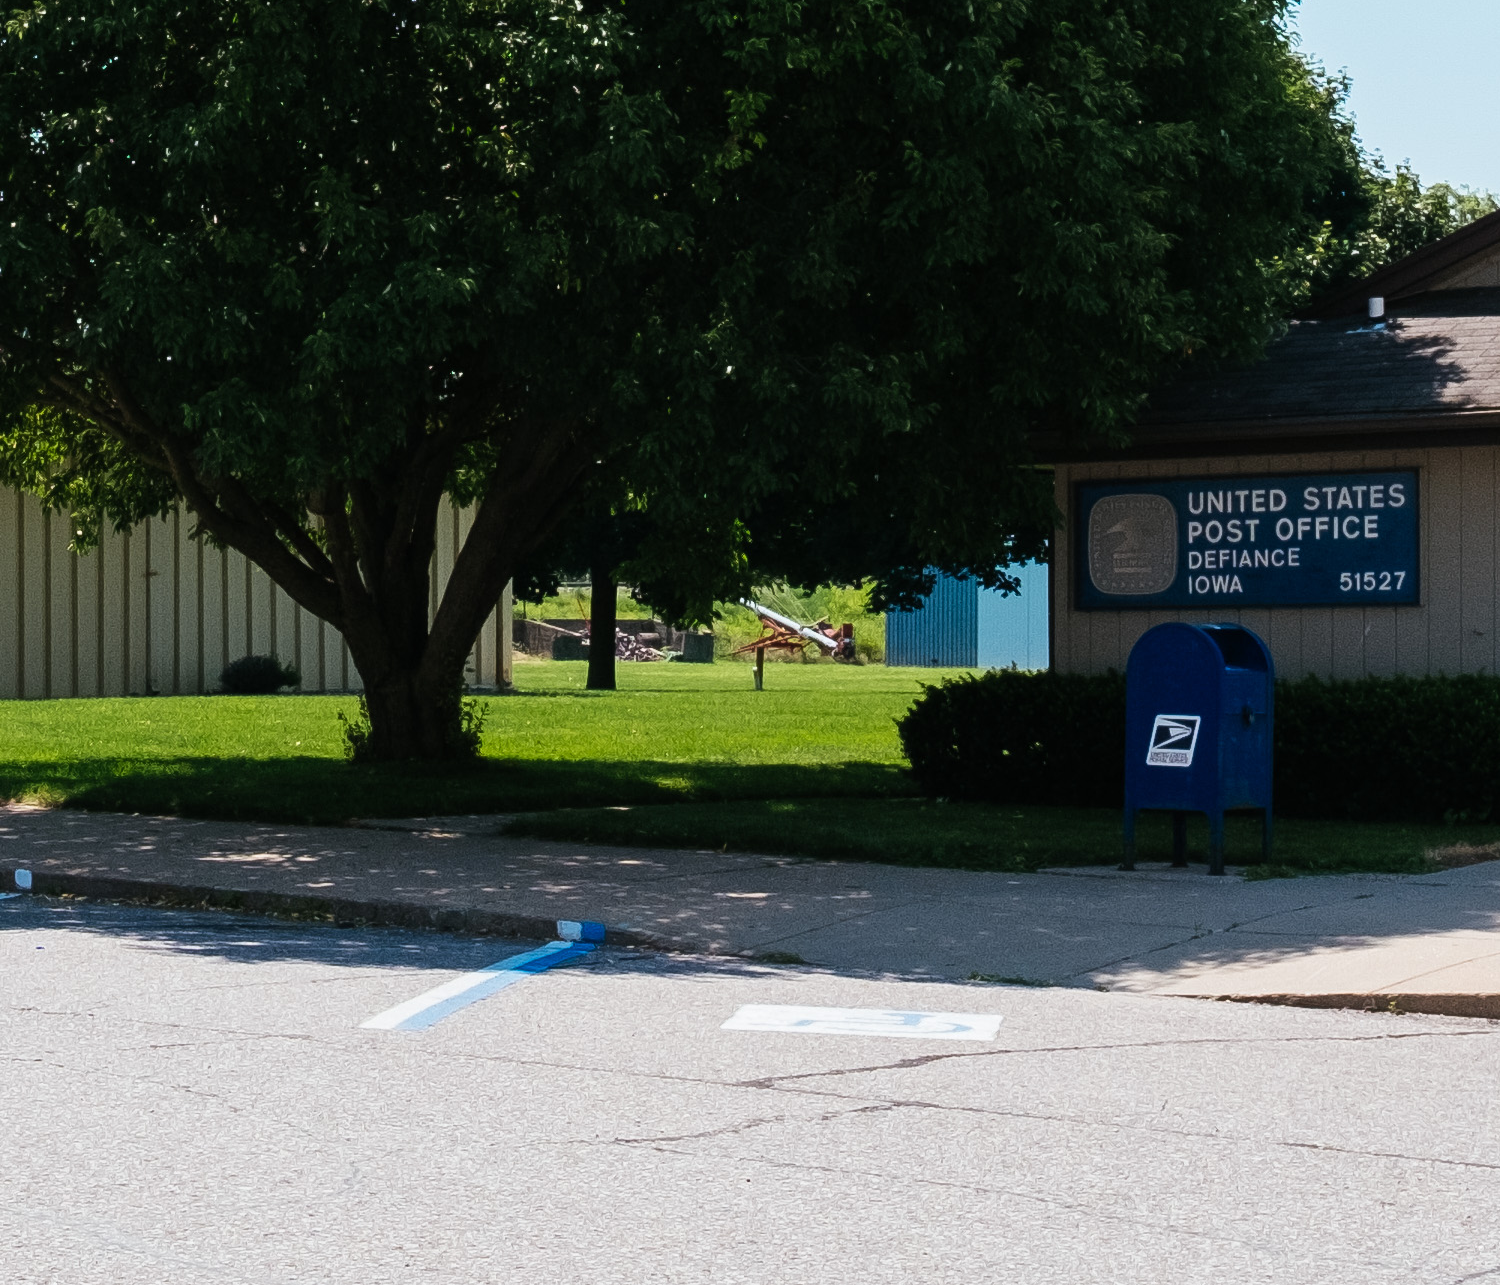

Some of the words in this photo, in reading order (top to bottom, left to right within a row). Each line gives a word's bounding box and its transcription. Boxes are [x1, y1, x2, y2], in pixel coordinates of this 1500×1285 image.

[1188, 489, 1287, 514] UNITED
[1303, 484, 1405, 510] STATES
[1188, 520, 1260, 543] POST
[1275, 515, 1379, 541] OFFICE
[1188, 547, 1300, 569] DEFIANCE
[1188, 573, 1243, 595] IOWA
[1339, 571, 1406, 592] 51527
